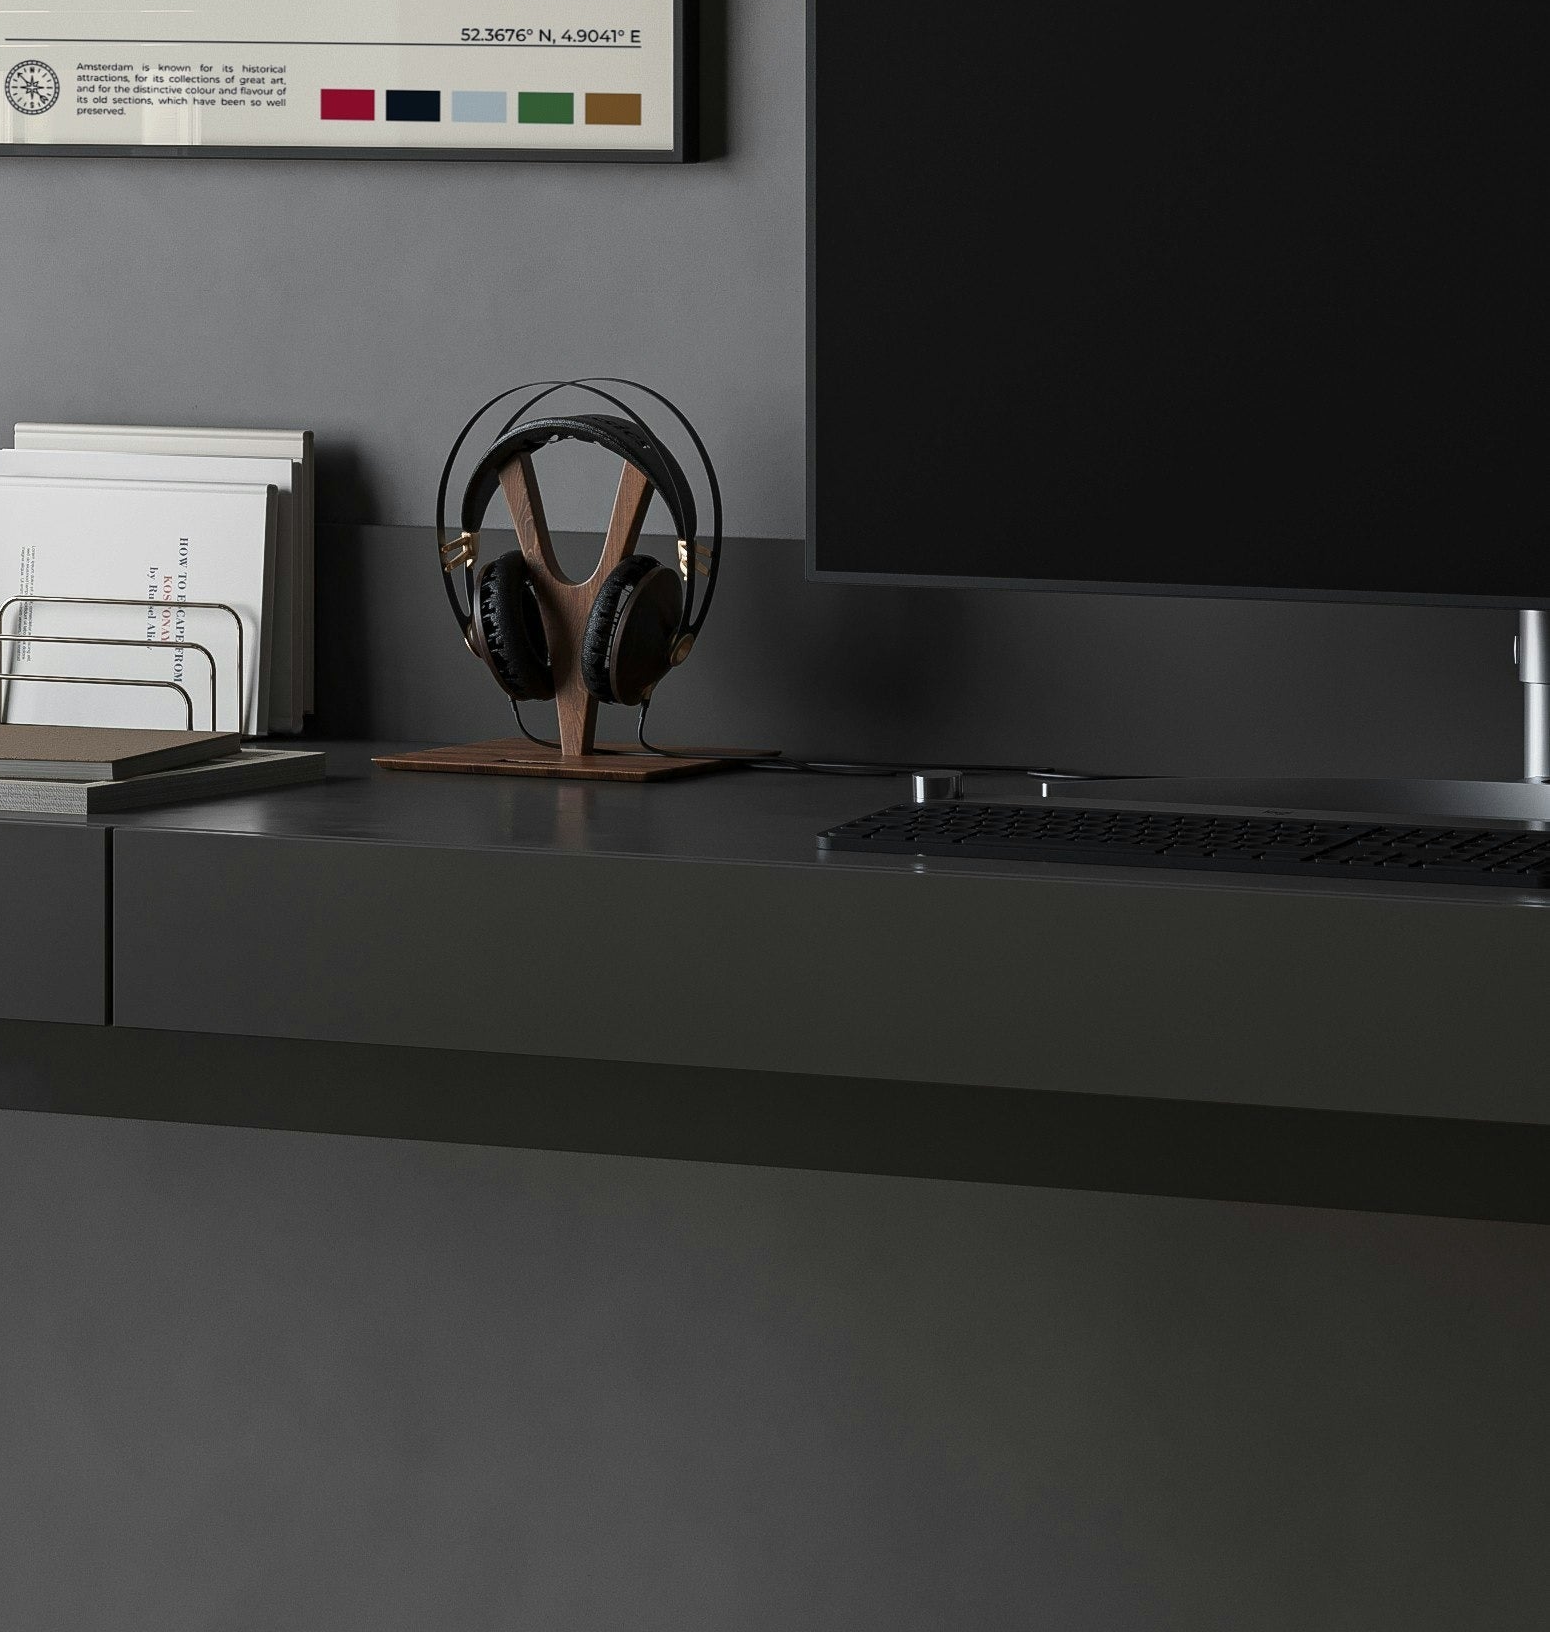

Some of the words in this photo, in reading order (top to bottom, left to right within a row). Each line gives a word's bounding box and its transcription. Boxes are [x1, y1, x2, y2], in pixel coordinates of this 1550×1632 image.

[461, 28, 534, 43] 52.3676°
[539, 29, 556, 44] N,
[561, 29, 625, 43] 4.9041°
[631, 30, 641, 43] E
[76, 62, 134, 71] Amsterdam
[142, 63, 150, 72] is
[158, 64, 191, 72] known
[200, 64, 213, 72] for
[222, 64, 234, 73] its
[242, 65, 286, 73] historical
[76, 74, 130, 83] attractions,
[135, 74, 148, 82] for
[153, 75, 164, 83] its
[168, 75, 220, 84] collections
[225, 75, 235, 84] of
[239, 77, 265, 85] great
[76, 85, 95, 93] and
[98, 84, 111, 93] for
[114, 85, 130, 93] the
[132, 85, 183, 94] distinctive
[185, 86, 215, 95] colour
[218, 87, 237, 95] and
[240, 87, 273, 95] flavour
[276, 87, 287, 96] of
[76, 95, 88, 104] its
[92, 96, 108, 104] old
[112, 96, 154, 105] sections,
[158, 97, 188, 105] which
[193, 97, 216, 106] have
[221, 98, 246, 106] been
[266, 99, 286, 107] well
[76, 107, 126, 116] preserved.
[179, 538, 189, 568] HOW
[147, 567, 159, 580] by
[177, 573, 188, 590] TO
[147, 585, 158, 619] Rusel
[173, 647, 184, 683] FROM
